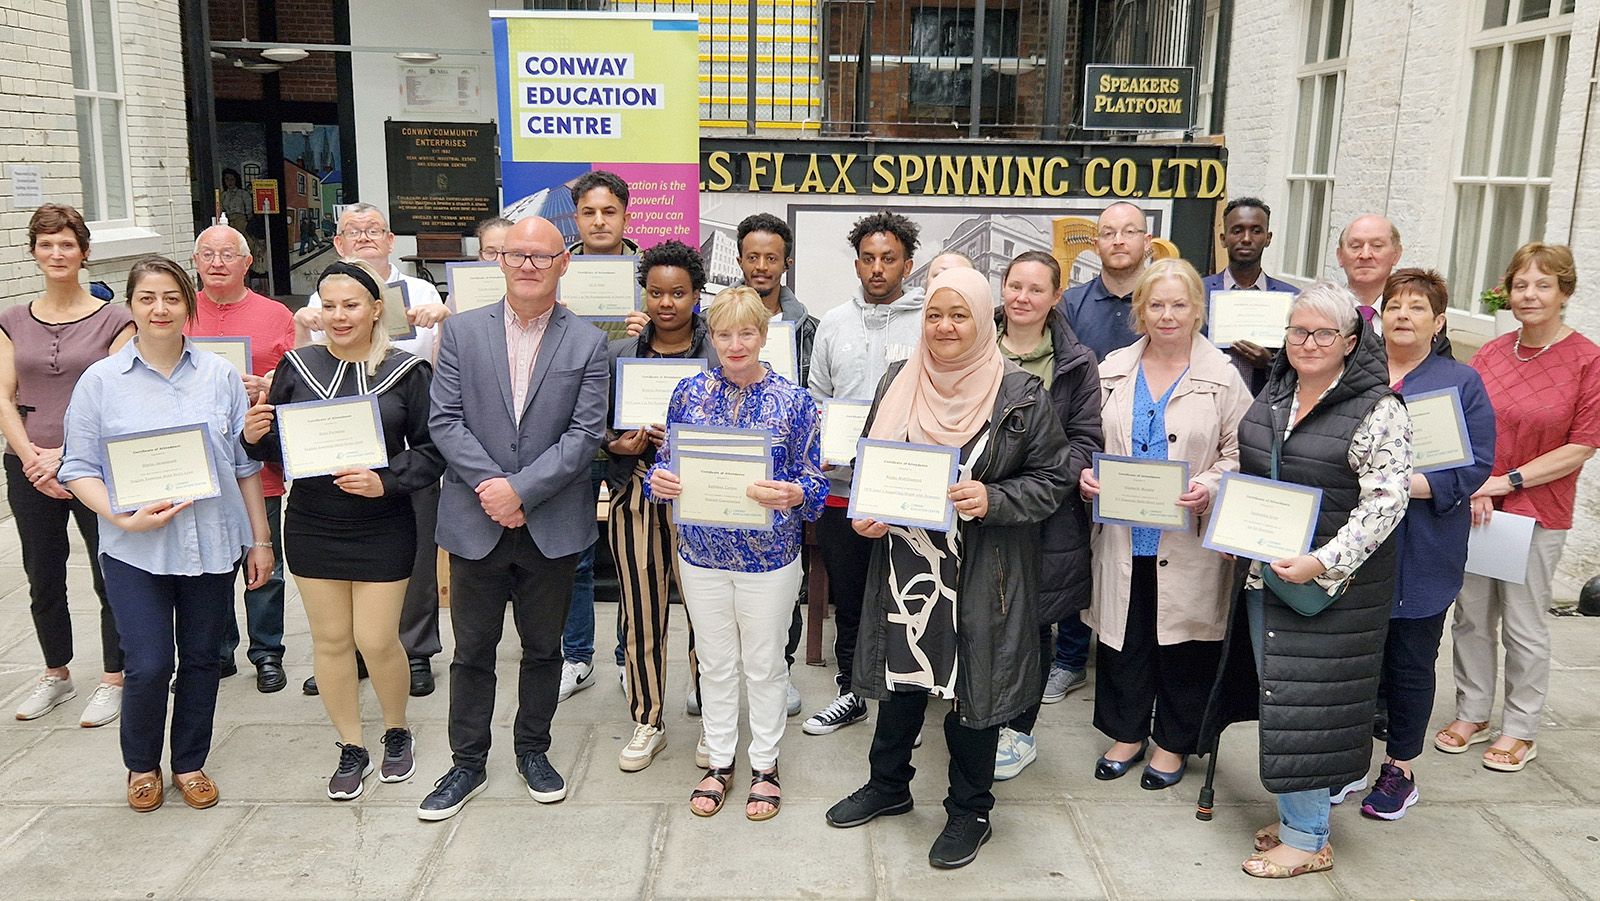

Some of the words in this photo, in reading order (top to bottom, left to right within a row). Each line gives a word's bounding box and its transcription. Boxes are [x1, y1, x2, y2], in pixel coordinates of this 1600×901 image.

[525, 56, 628, 76] CONWAY
[1099, 74, 1180, 94] SPEAKERS
[526, 86, 657, 106] EDUCATION
[1093, 94, 1183, 114] PLATFORM
[401, 128, 432, 136] CONWAY
[433, 128, 479, 137] COMMUNITY
[527, 116, 612, 135] CENTRE
[415, 138, 467, 147] ENTERPRISES
[747, 152, 857, 194] FLAX
[871, 154, 1069, 197] SPINNING
[627, 181, 658, 191] cation
[660, 180, 669, 191] is
[670, 180, 687, 191] the
[630, 194, 675, 207] powerful
[630, 212, 643, 220] on
[645, 212, 664, 222] you
[665, 212, 684, 220] can
[635, 224, 672, 237] change
[674, 224, 690, 234] the
